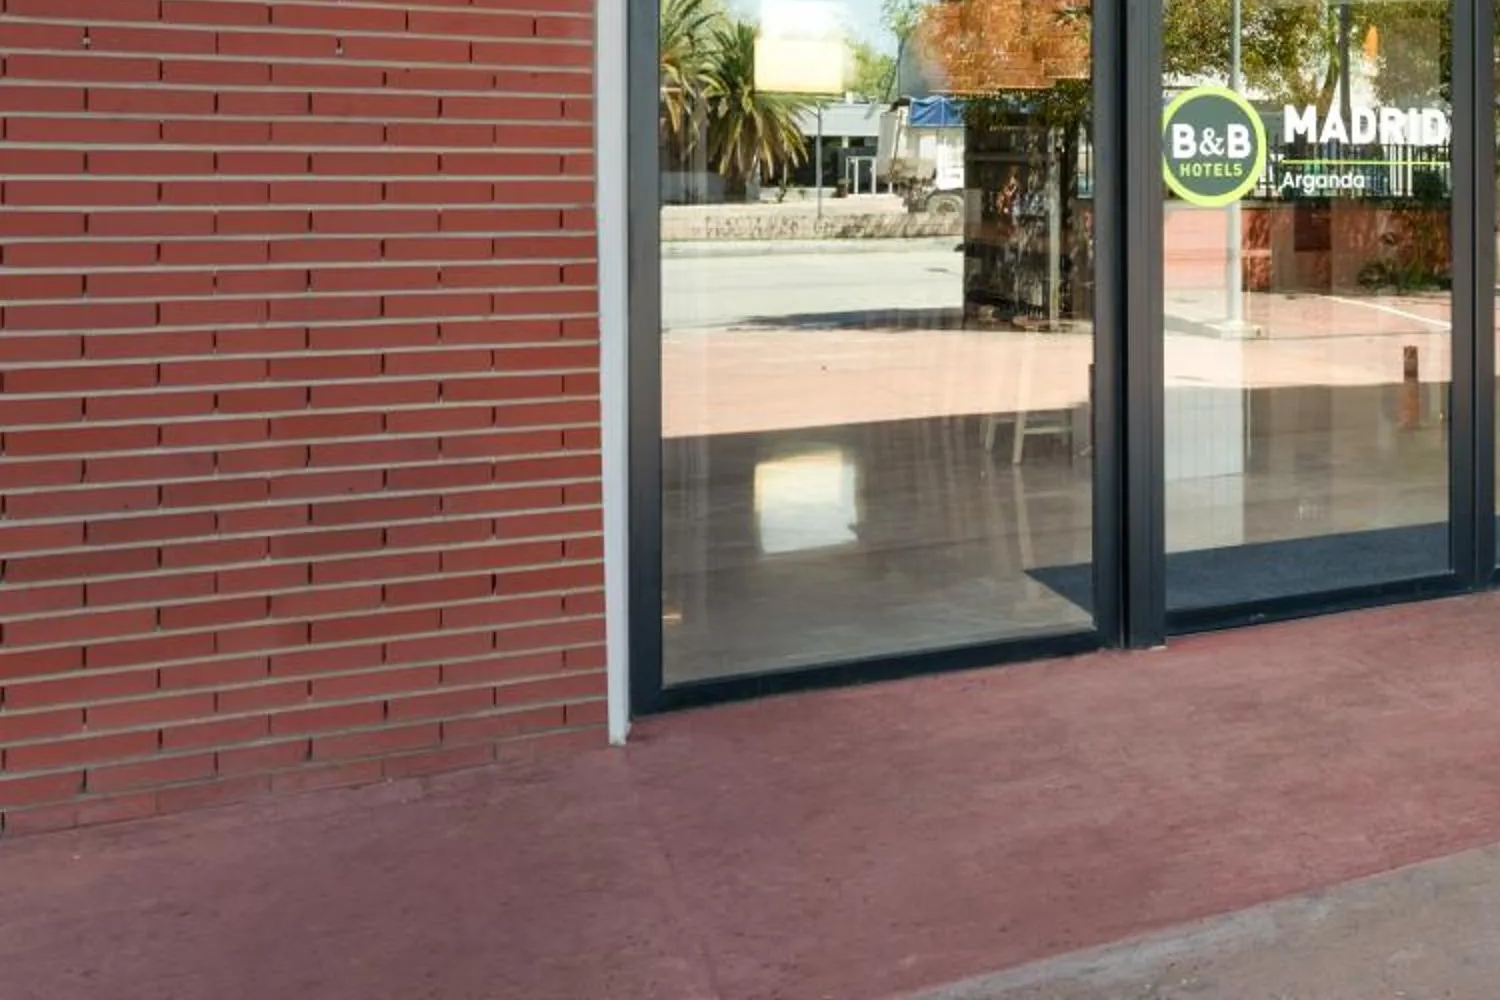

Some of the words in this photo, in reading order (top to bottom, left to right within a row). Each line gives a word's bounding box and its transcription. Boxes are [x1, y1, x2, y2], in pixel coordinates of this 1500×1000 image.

[1284, 104, 1447, 146] MADRID
[1172, 123, 1251, 159] B&B
[1180, 163, 1243, 177] HOTELS
[1281, 171, 1366, 192] Arganda
